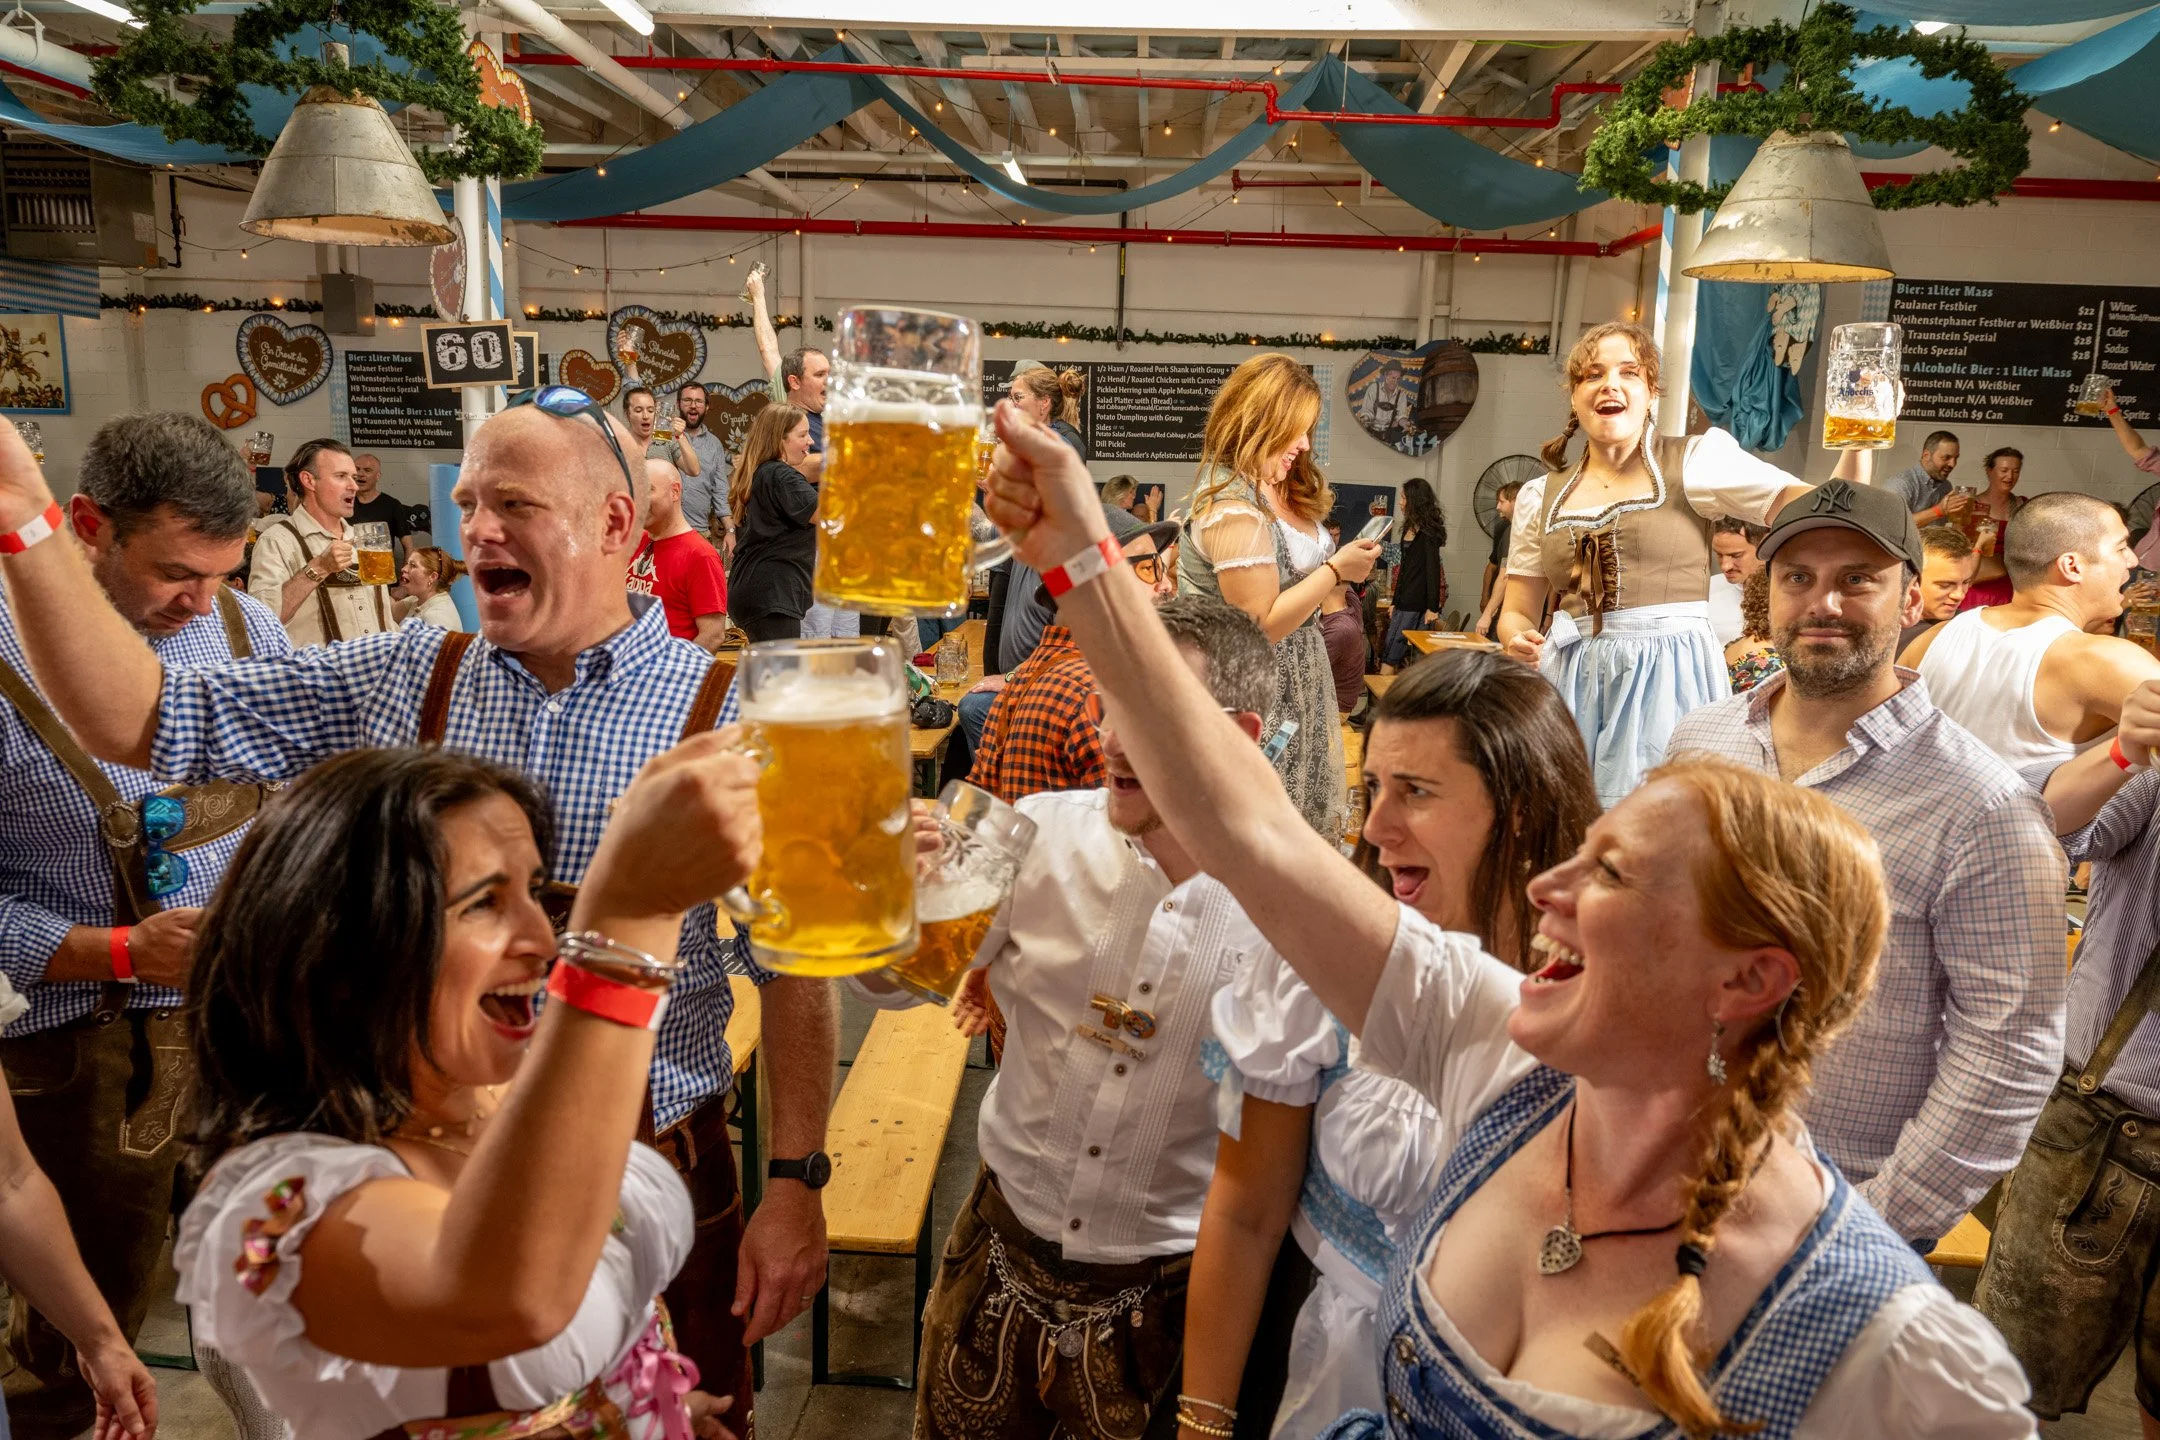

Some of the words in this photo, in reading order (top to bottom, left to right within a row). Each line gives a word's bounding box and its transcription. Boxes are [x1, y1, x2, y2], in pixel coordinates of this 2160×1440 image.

[1897, 284, 1924, 294] Bier:
[1928, 285, 1960, 296] 1Liter
[1964, 286, 1993, 297] Mass
[1894, 300, 1938, 310] Paulaner
[1940, 301, 1977, 312] Festbier
[2078, 306, 2095, 316] $22
[1893, 315, 1977, 327] Weihenstephaner
[1979, 318, 2016, 328] Festbier
[2030, 320, 2073, 330] Weißbier
[2076, 321, 2093, 331] $22
[1908, 330, 1960, 340] Traunstein
[1963, 332, 1997, 343] Spezial
[2074, 336, 2092, 345] $28
[2107, 327, 2129, 337] Cider
[436, 330, 503, 371] 60
[1901, 345, 1928, 355] dechs
[1931, 346, 1967, 357] Spezial
[2072, 351, 2090, 360] $28
[2104, 344, 2129, 354] Sodas
[348, 354, 367, 362] Bier:
[1206, 367, 1224, 375] Gravy
[1913, 362, 1967, 374] Alcoholic
[1970, 364, 1993, 375] Bier
[2012, 365, 2039, 377] Liter
[2042, 367, 2072, 378] Mass
[2101, 360, 2128, 370] Boxed
[2130, 361, 2157, 371] Water
[350, 375, 404, 384] Weihenstephaner
[1903, 377, 1952, 388] Traunstein
[1955, 379, 1975, 390] N/A
[1978, 380, 2021, 391] Weißbier
[2068, 383, 2080, 393] $2
[397, 386, 419, 394] Spezial
[1119, 387, 1141, 395] Herring
[1158, 387, 1175, 395] Apple
[1177, 387, 1203, 395] Mustard,
[378, 396, 402, 404] Spezial
[1905, 394, 1964, 404] enstephaner
[1967, 394, 1986, 405] N/A
[1990, 396, 2033, 406] Weißbier
[2066, 399, 2076, 408] $2
[370, 407, 404, 415] Alcoholic
[1938, 408, 1968, 418] Kölsch
[1971, 410, 1983, 420] $9
[1985, 410, 2003, 419] Can
[2063, 413, 2079, 422] $22
[2123, 410, 2151, 421] Spritz
[1117, 414, 1147, 422] Dumpling
[353, 428, 407, 436] Weihenstephaner
[1810, 481, 1856, 513] NY
[624, 573, 654, 594] appa
